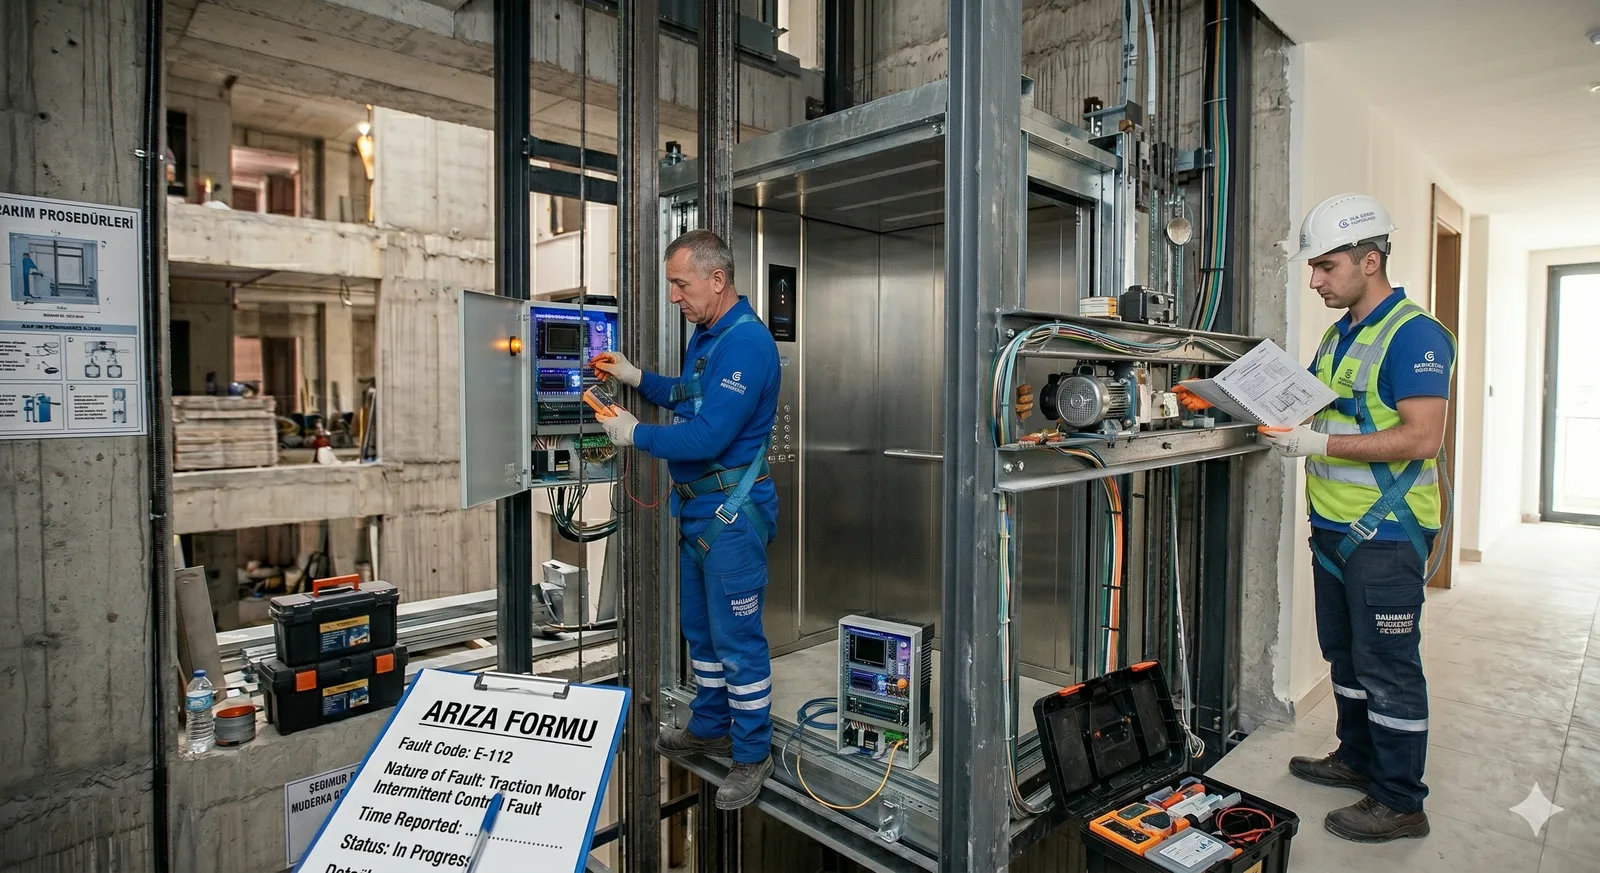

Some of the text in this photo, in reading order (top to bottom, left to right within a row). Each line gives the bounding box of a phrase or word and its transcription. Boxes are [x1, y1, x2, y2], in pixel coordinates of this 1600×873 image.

[39, 208, 134, 229] PROSEDÜRLERİ
[421, 700, 598, 742] ARIZA FORMU
[398, 736, 514, 764] Fault Code: E-112
[384, 761, 587, 801] Nature of Fault: Traction Motor
[291, 792, 332, 814] MUDERKA
[373, 779, 543, 816] Intermittent Contrl Fault
[358, 805, 463, 835] Time Reported:
[340, 833, 390, 855] Status:
[392, 841, 407, 858] In
